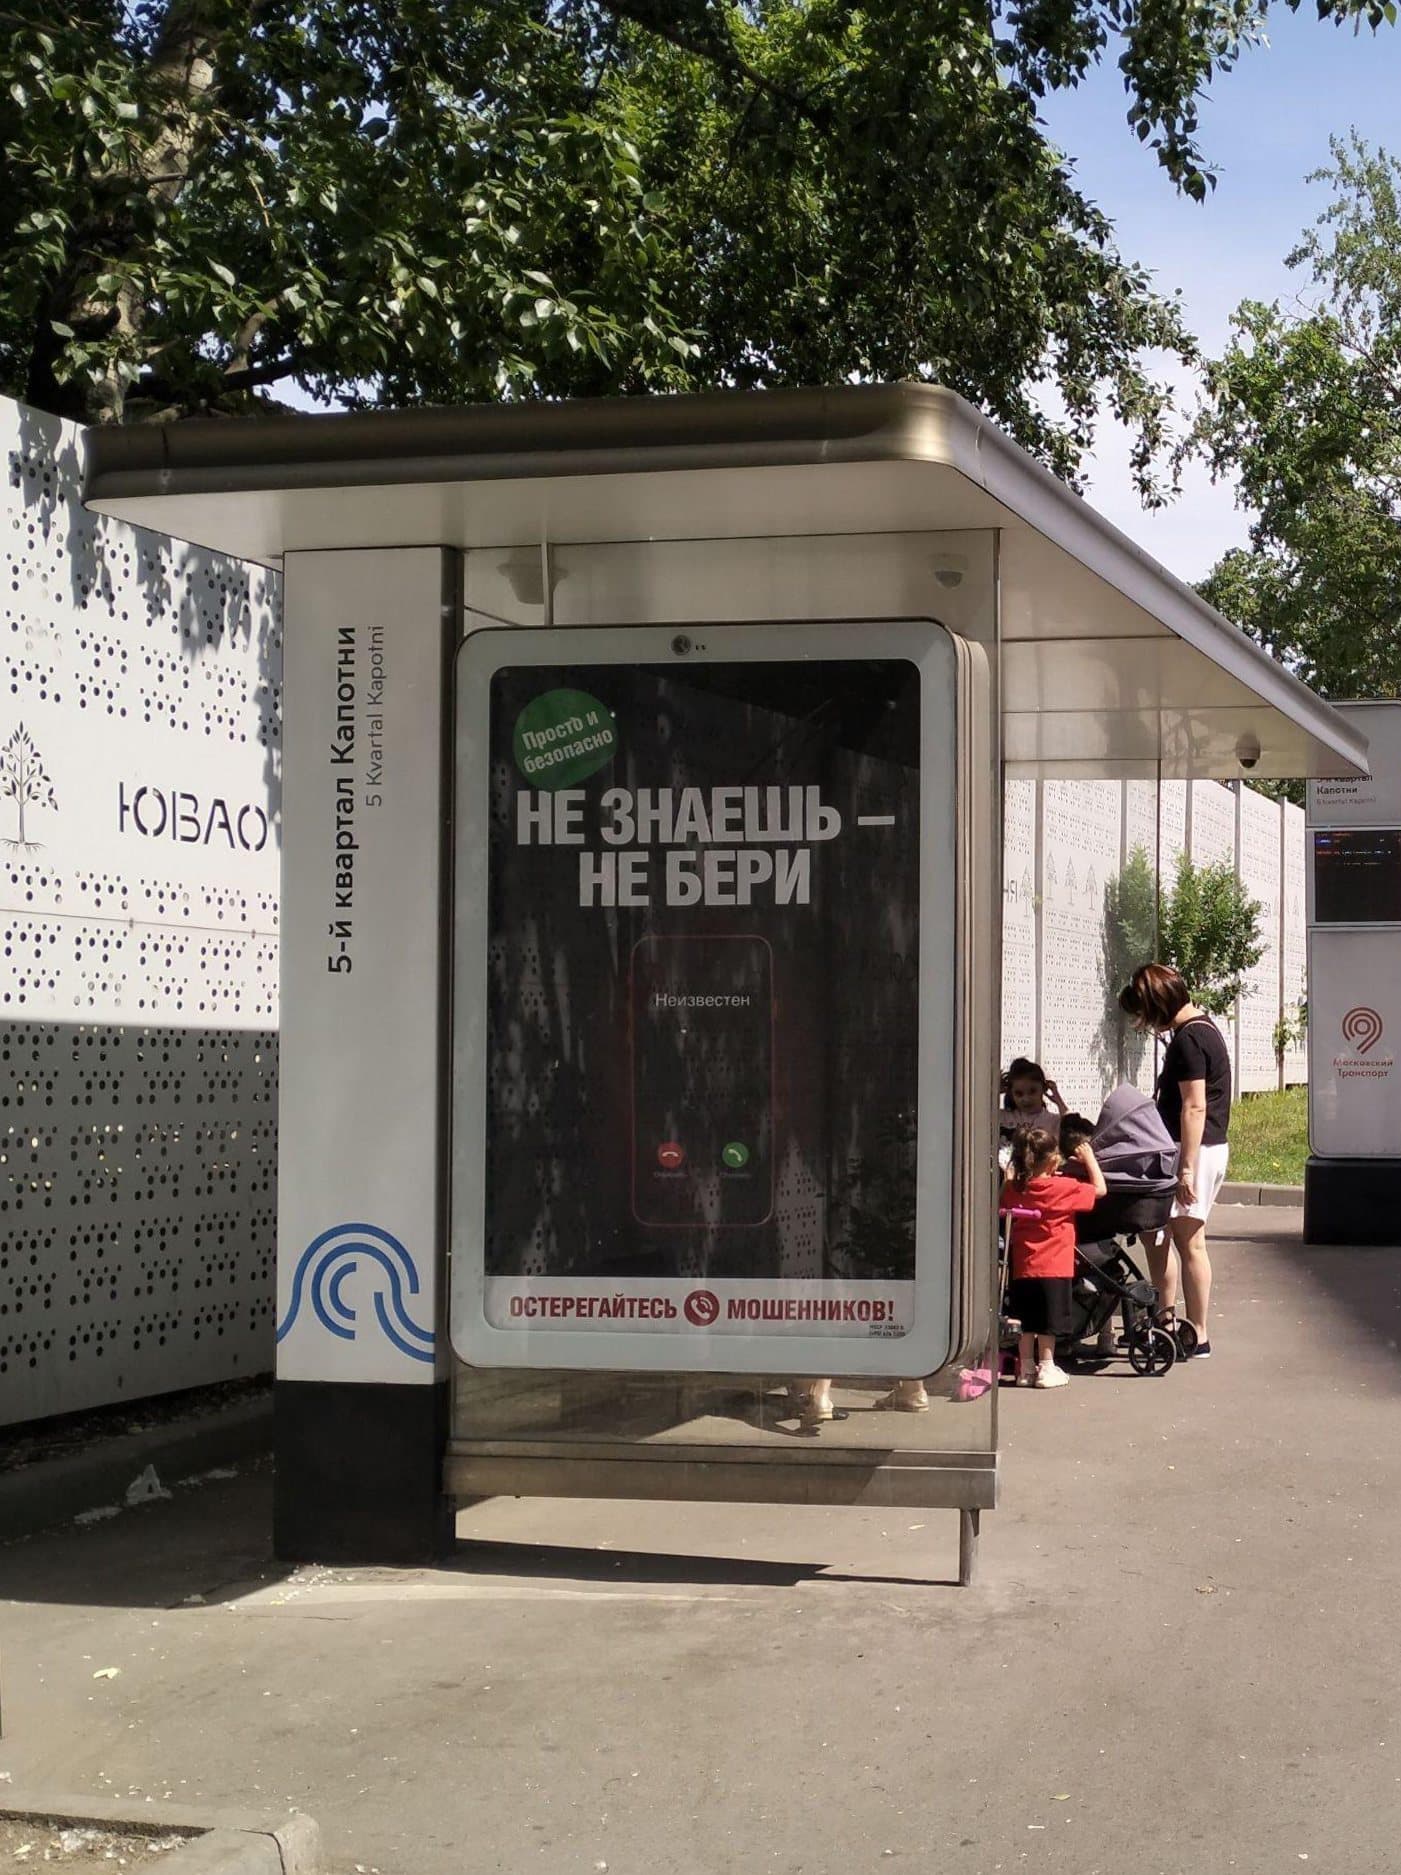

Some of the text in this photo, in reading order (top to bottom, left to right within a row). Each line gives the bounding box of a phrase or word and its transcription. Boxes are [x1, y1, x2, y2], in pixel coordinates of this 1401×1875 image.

[365, 626, 386, 806] 5 Kvartal Kapotni
[522, 710, 599, 751] Просто и
[522, 729, 614, 773] безопасно
[328, 627, 359, 974] 5-й квартал Капотни
[1316, 786, 1358, 795] Капотни
[119, 781, 268, 852] ЮВАО
[517, 789, 586, 846] НЕ
[600, 785, 842, 845] ЗНАЕШЬ
[579, 848, 811, 907] НЕ БЕРИ
[655, 993, 750, 1008] Неизвестен
[1333, 1057, 1393, 1067] Московский
[1337, 1068, 1389, 1080] Транспорт
[510, 1293, 894, 1322] ОСТЕРЕГАЙТЕСЬ МОШЕННИКОВ!
